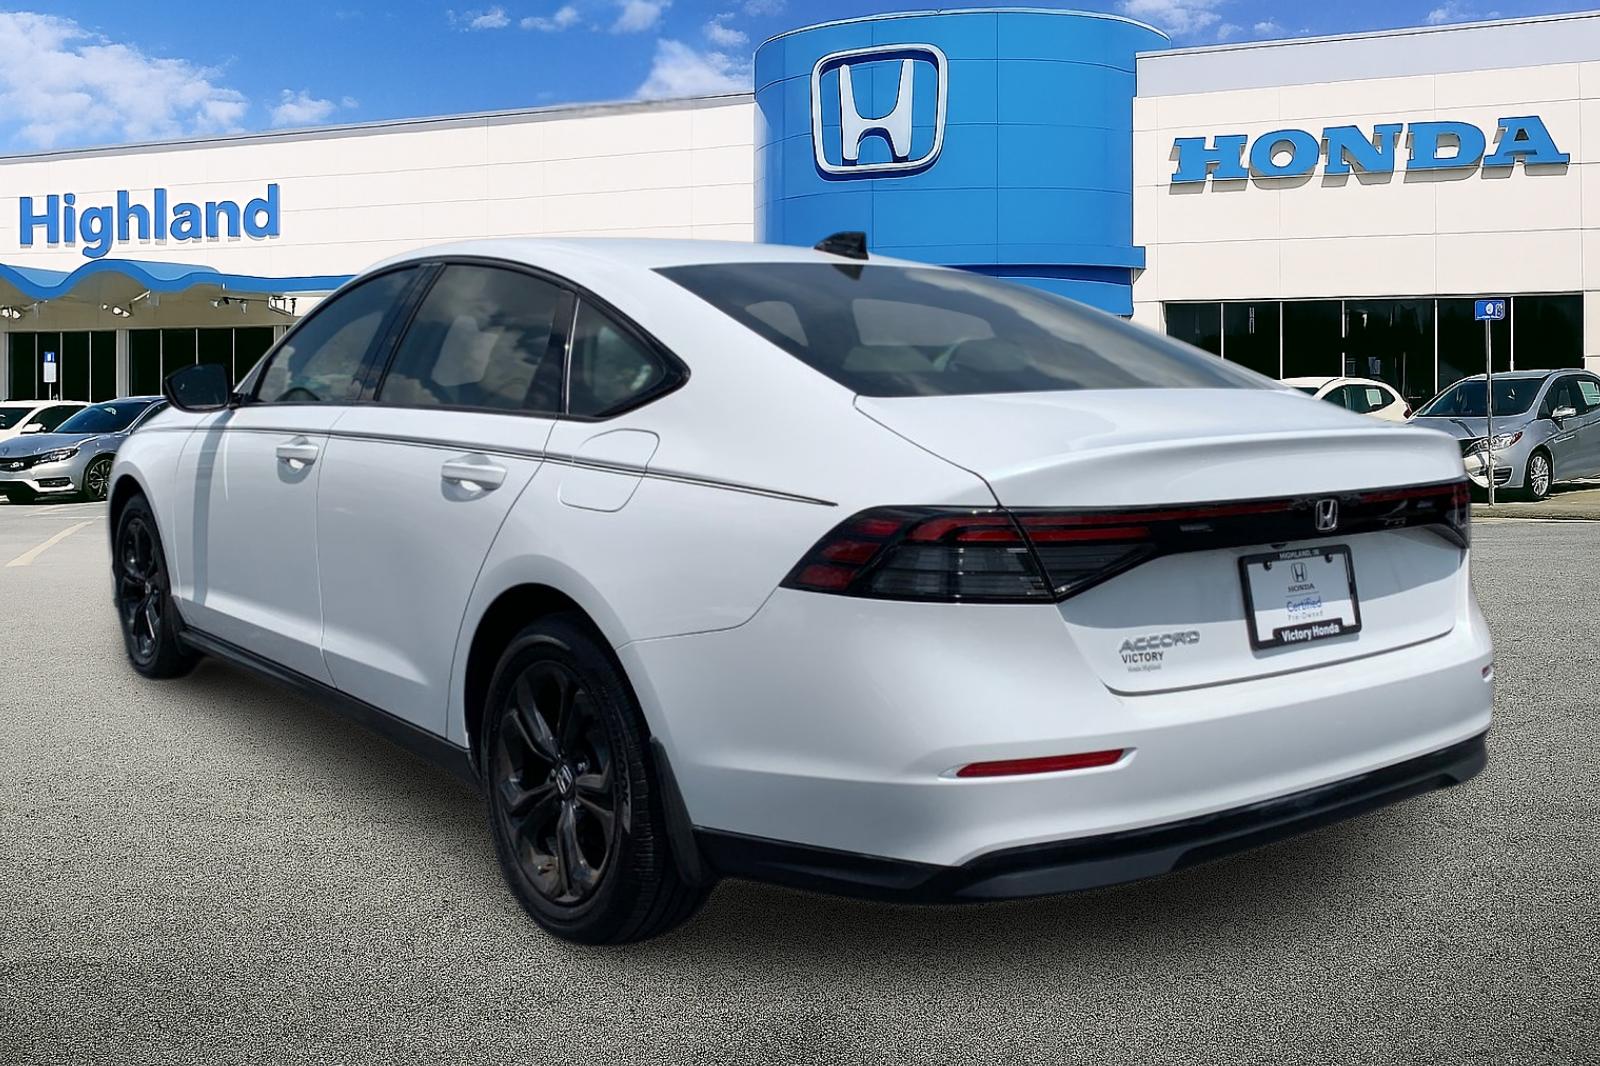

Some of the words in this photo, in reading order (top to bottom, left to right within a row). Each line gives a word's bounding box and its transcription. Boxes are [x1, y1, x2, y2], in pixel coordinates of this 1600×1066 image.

[1170, 115, 1570, 184] HONDA
[19, 183, 280, 258] Highland
[1287, 583, 1315, 592] HONDA
[1287, 595, 1322, 612] Certified
[1119, 630, 1200, 653] ACCORD
[1281, 628, 1312, 642] Victory
[1312, 623, 1340, 637] Honda
[1121, 651, 1164, 664] VICTORY
